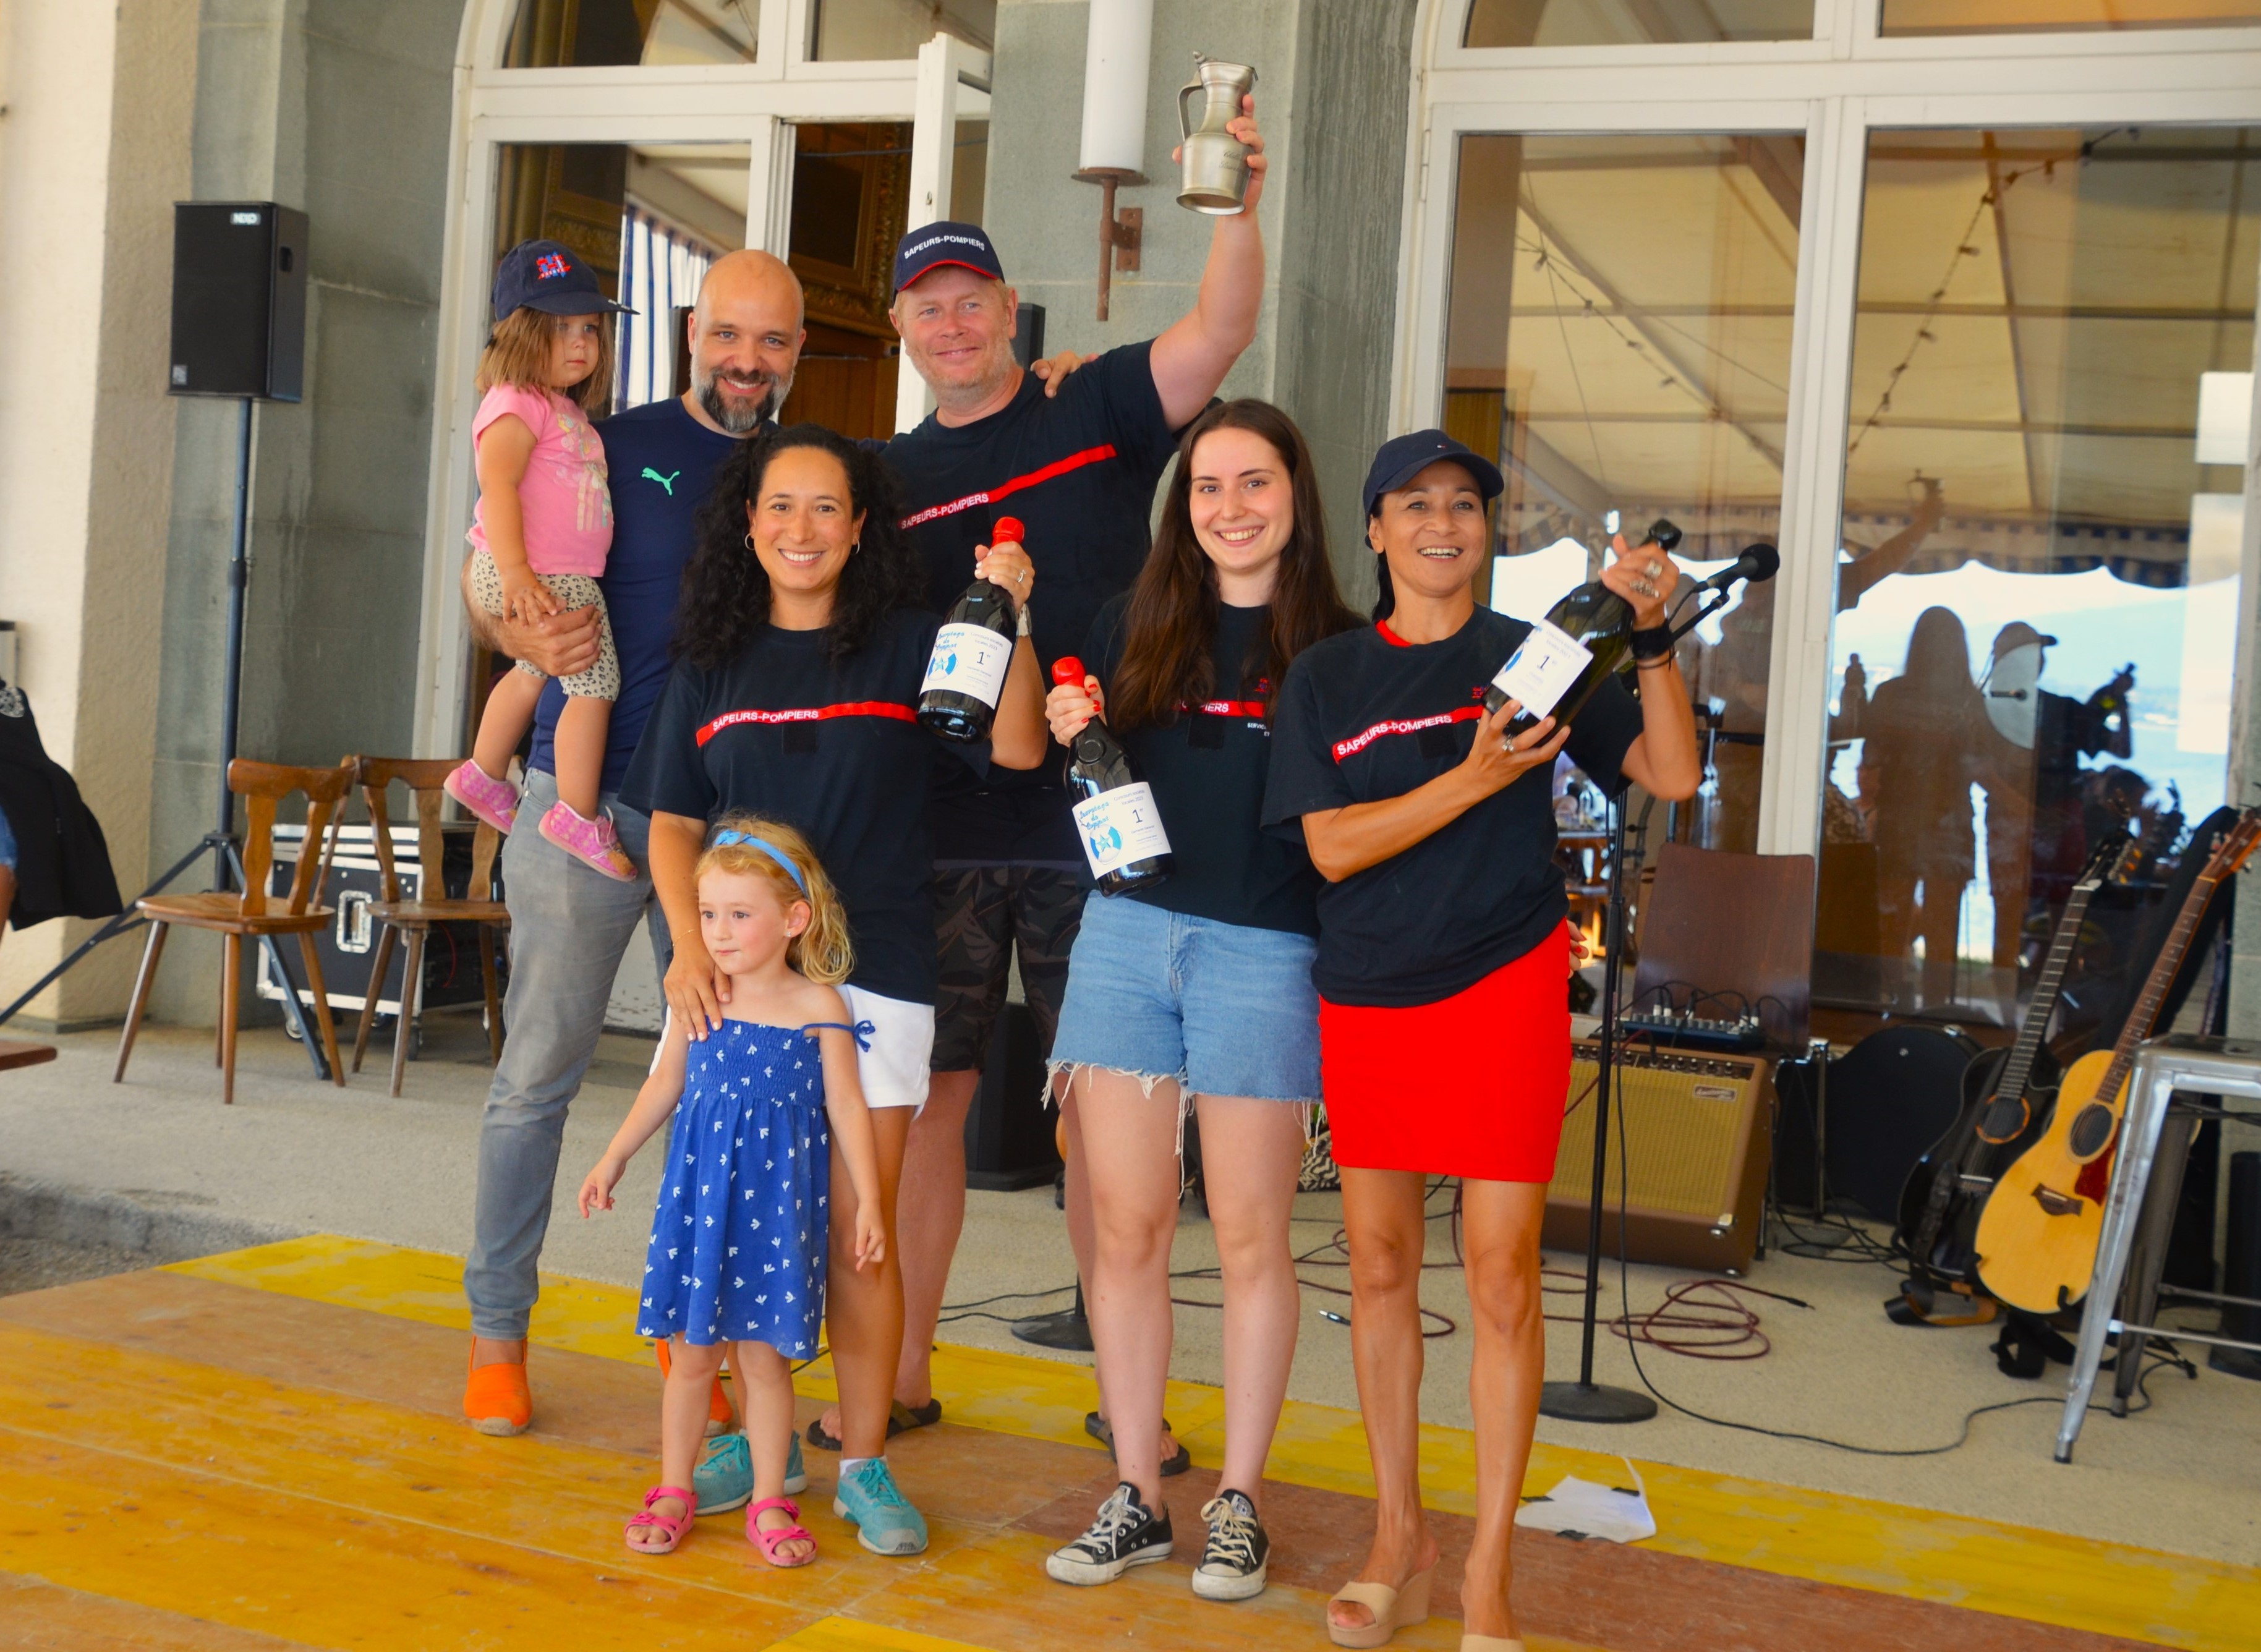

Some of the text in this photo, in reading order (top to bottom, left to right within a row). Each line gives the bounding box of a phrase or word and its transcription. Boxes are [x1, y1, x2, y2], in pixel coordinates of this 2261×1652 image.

[904, 235, 985, 259] SAPEURS-POMPIERS
[901, 493, 989, 529] SAPEURS-POMPIERS
[713, 710, 819, 731] SAPEURS-POMPIERS
[1337, 715, 1452, 756] SAPEURS-POMPIERS
